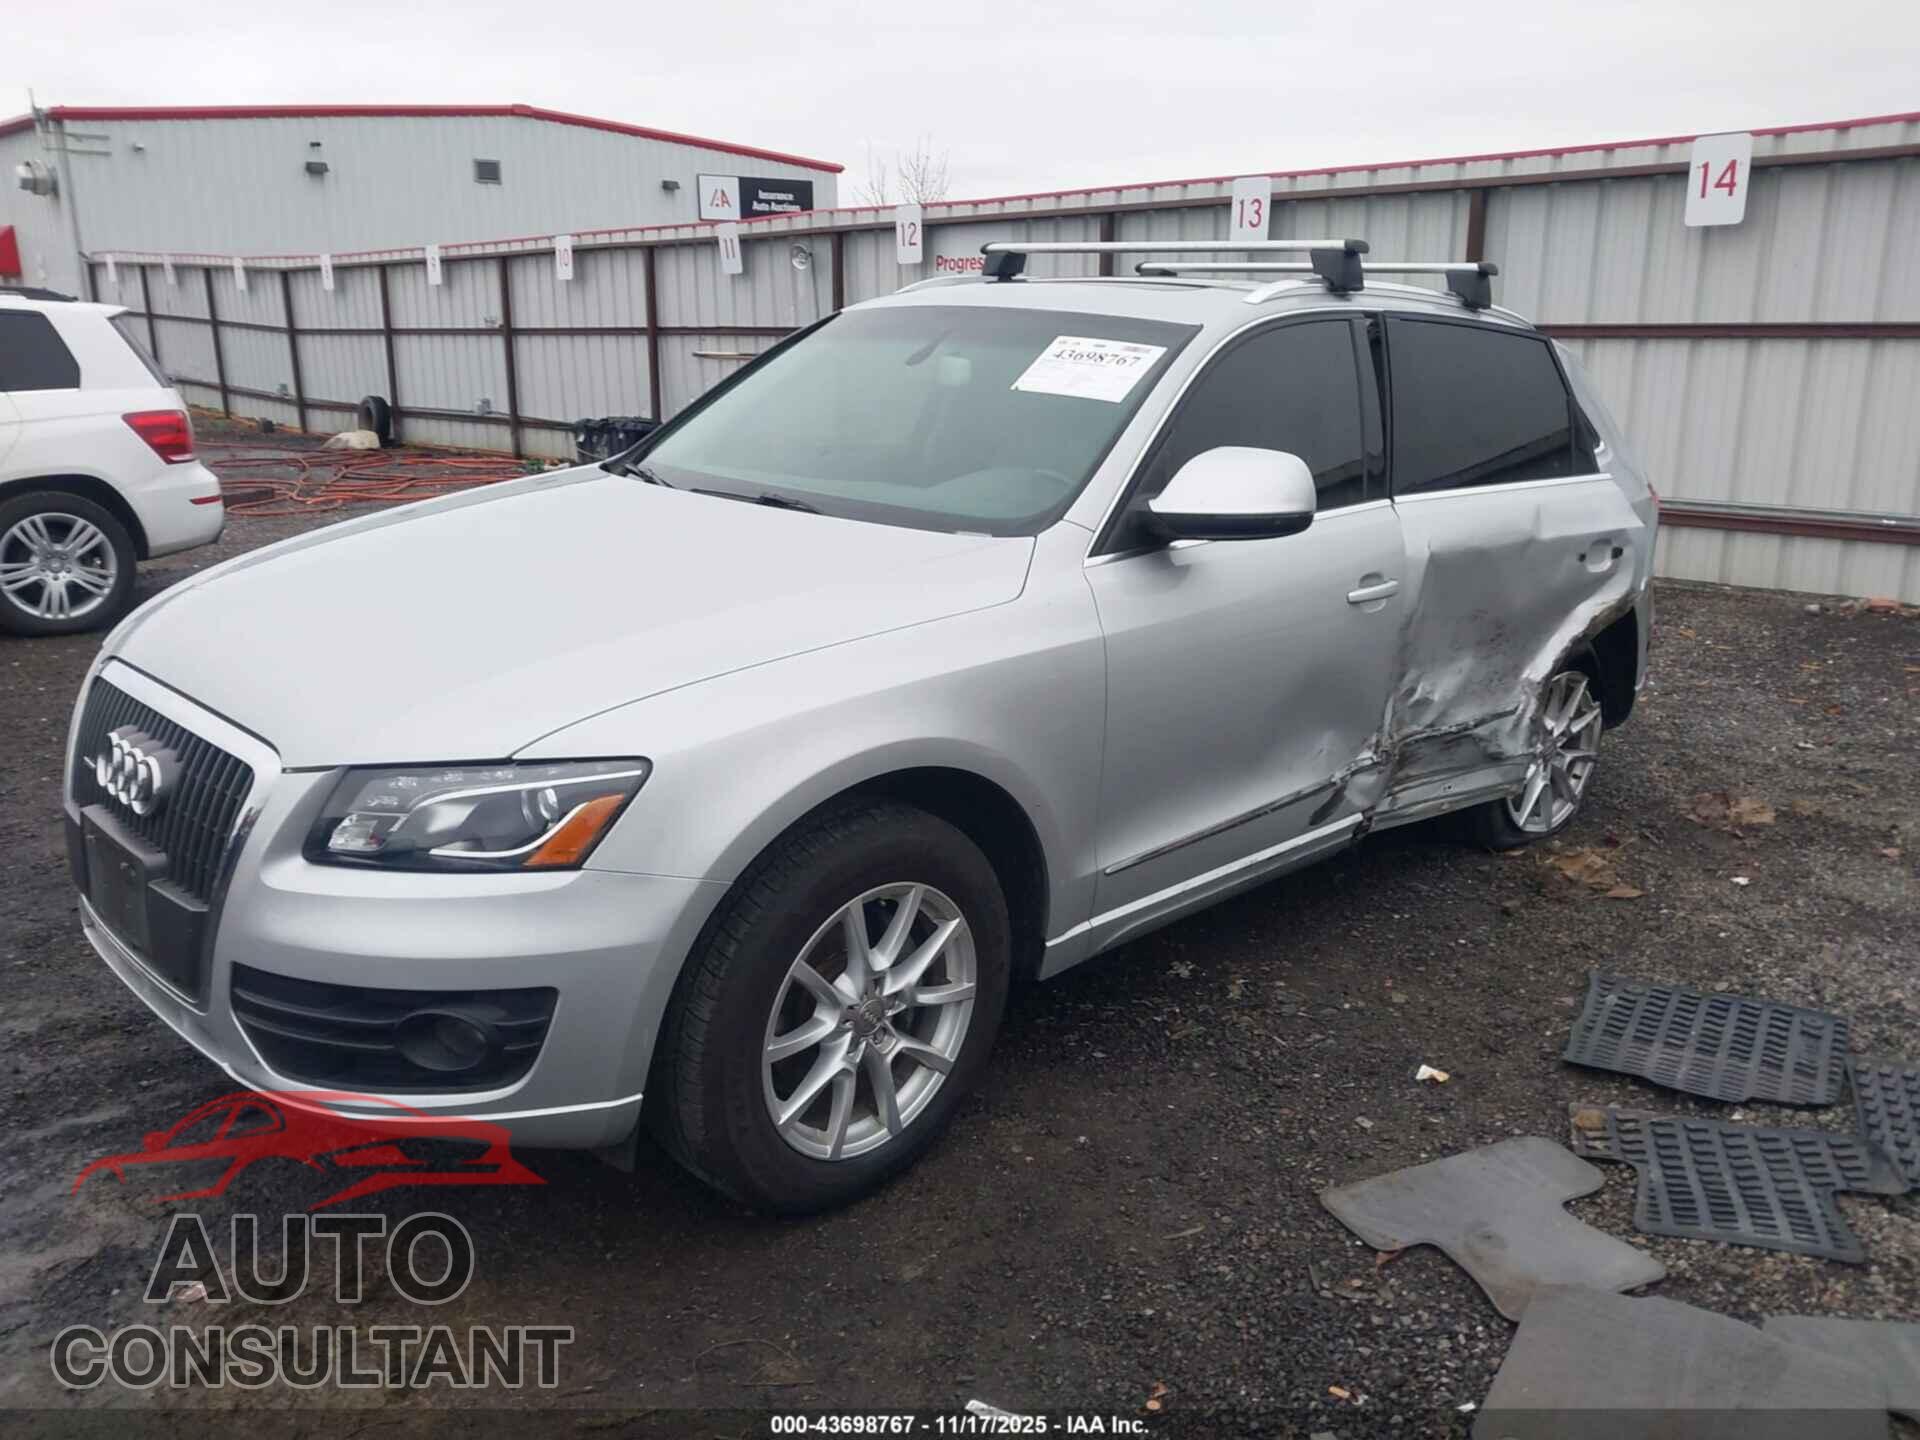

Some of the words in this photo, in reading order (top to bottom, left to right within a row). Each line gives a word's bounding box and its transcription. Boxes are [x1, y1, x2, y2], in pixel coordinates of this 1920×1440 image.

[1697, 159, 1737, 199] 14
[1240, 198, 1262, 228] 13
[901, 222, 918, 247] 12
[723, 238, 736, 258] 11
[1053, 349, 1142, 366] 43698767
